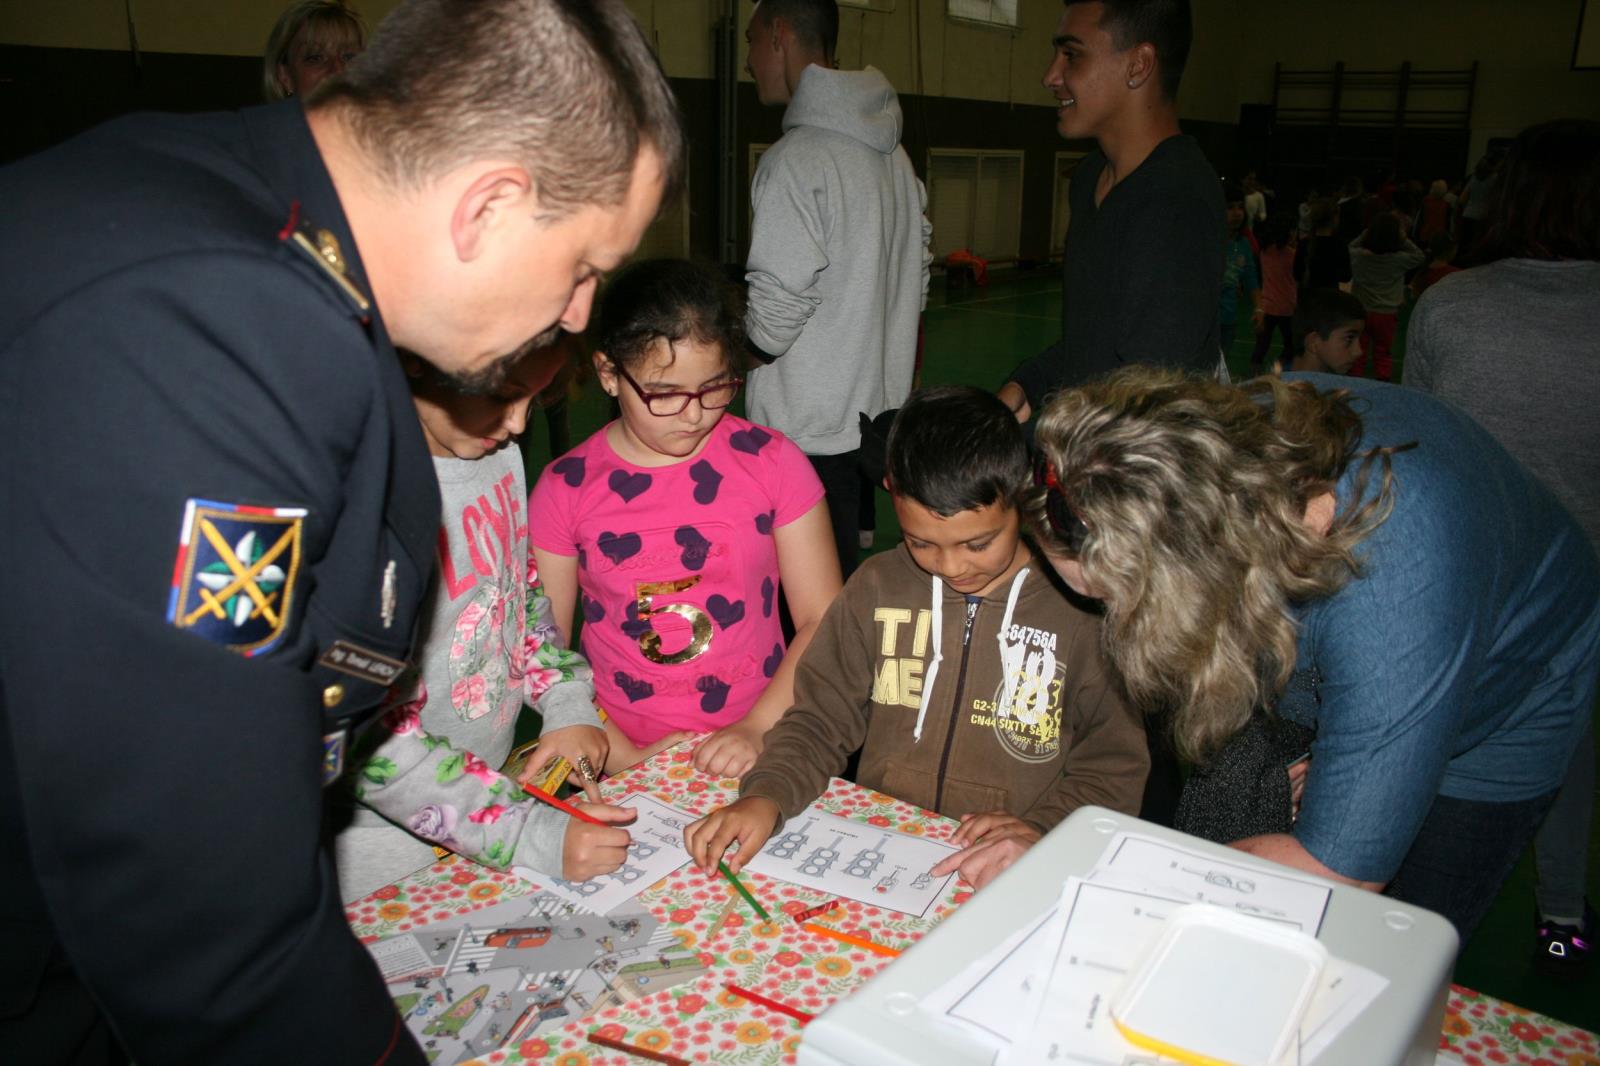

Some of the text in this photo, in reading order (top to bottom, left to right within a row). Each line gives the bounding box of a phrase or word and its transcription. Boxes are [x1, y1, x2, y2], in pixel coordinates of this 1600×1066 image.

[438, 471, 528, 601] LOVE
[635, 574, 714, 664] 5
[999, 718, 1027, 733] SIXTY
